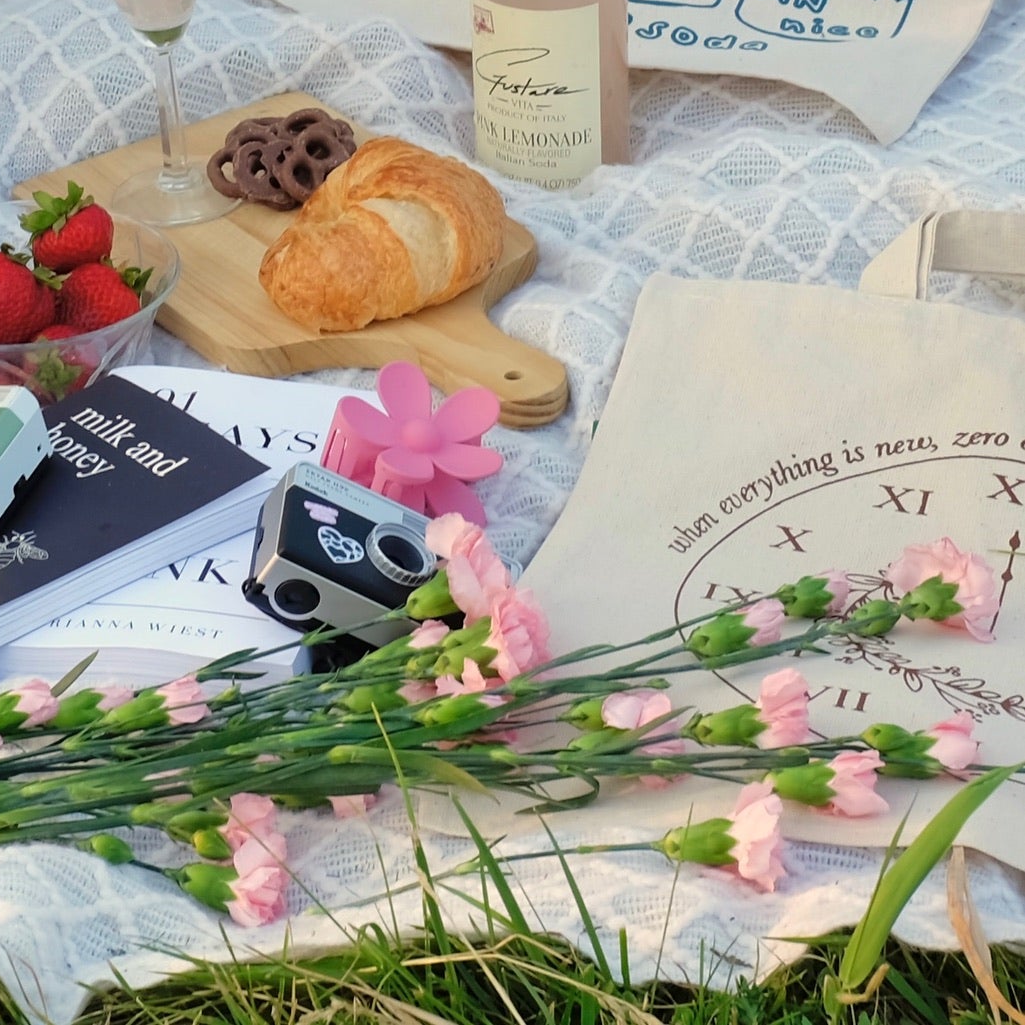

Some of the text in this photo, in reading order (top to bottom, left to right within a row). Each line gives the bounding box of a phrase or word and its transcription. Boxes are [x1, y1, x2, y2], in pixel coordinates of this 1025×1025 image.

[476, 48, 589, 96] Gustare
[487, 102, 567, 122] PRODUCT OF ITALY
[511, 99, 534, 111] VITA
[503, 126, 592, 147] LEMONADE
[496, 150, 557, 168] Italian Soda
[528, 149, 570, 158] FLAVORED
[48, 422, 115, 478] honey
[70, 407, 189, 477] milk and
[668, 431, 1009, 555] when everything is new, zero
[873, 485, 934, 516] XI
[770, 525, 813, 552] X
[149, 622, 225, 640] WIEST
